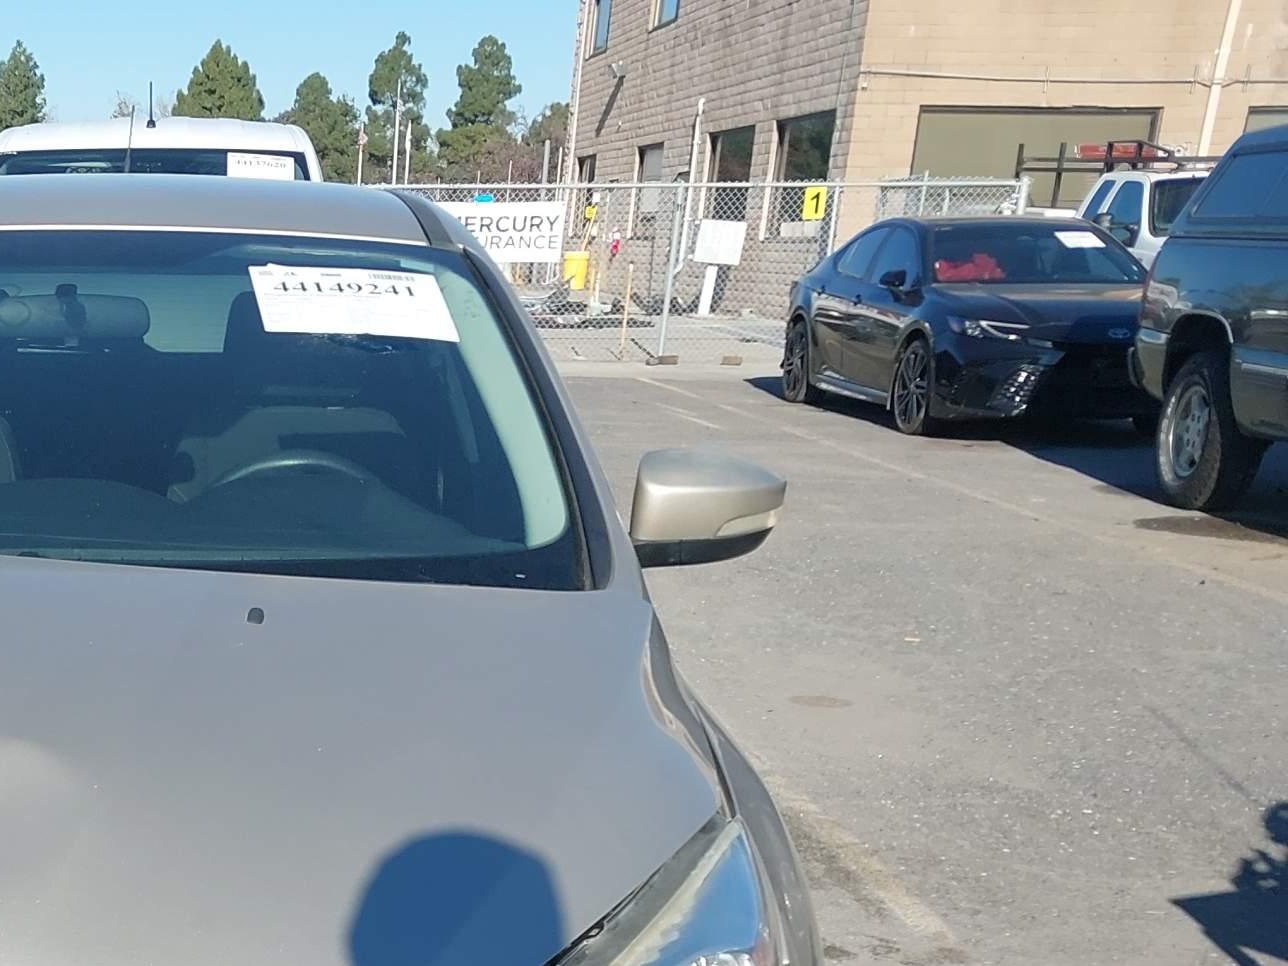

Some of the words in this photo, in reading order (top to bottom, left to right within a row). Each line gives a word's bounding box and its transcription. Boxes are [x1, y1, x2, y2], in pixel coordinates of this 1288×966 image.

[810, 191, 821, 214] 1
[458, 215, 560, 233] ERCURY
[474, 234, 560, 250] URANCE
[273, 280, 416, 298] 44149241
